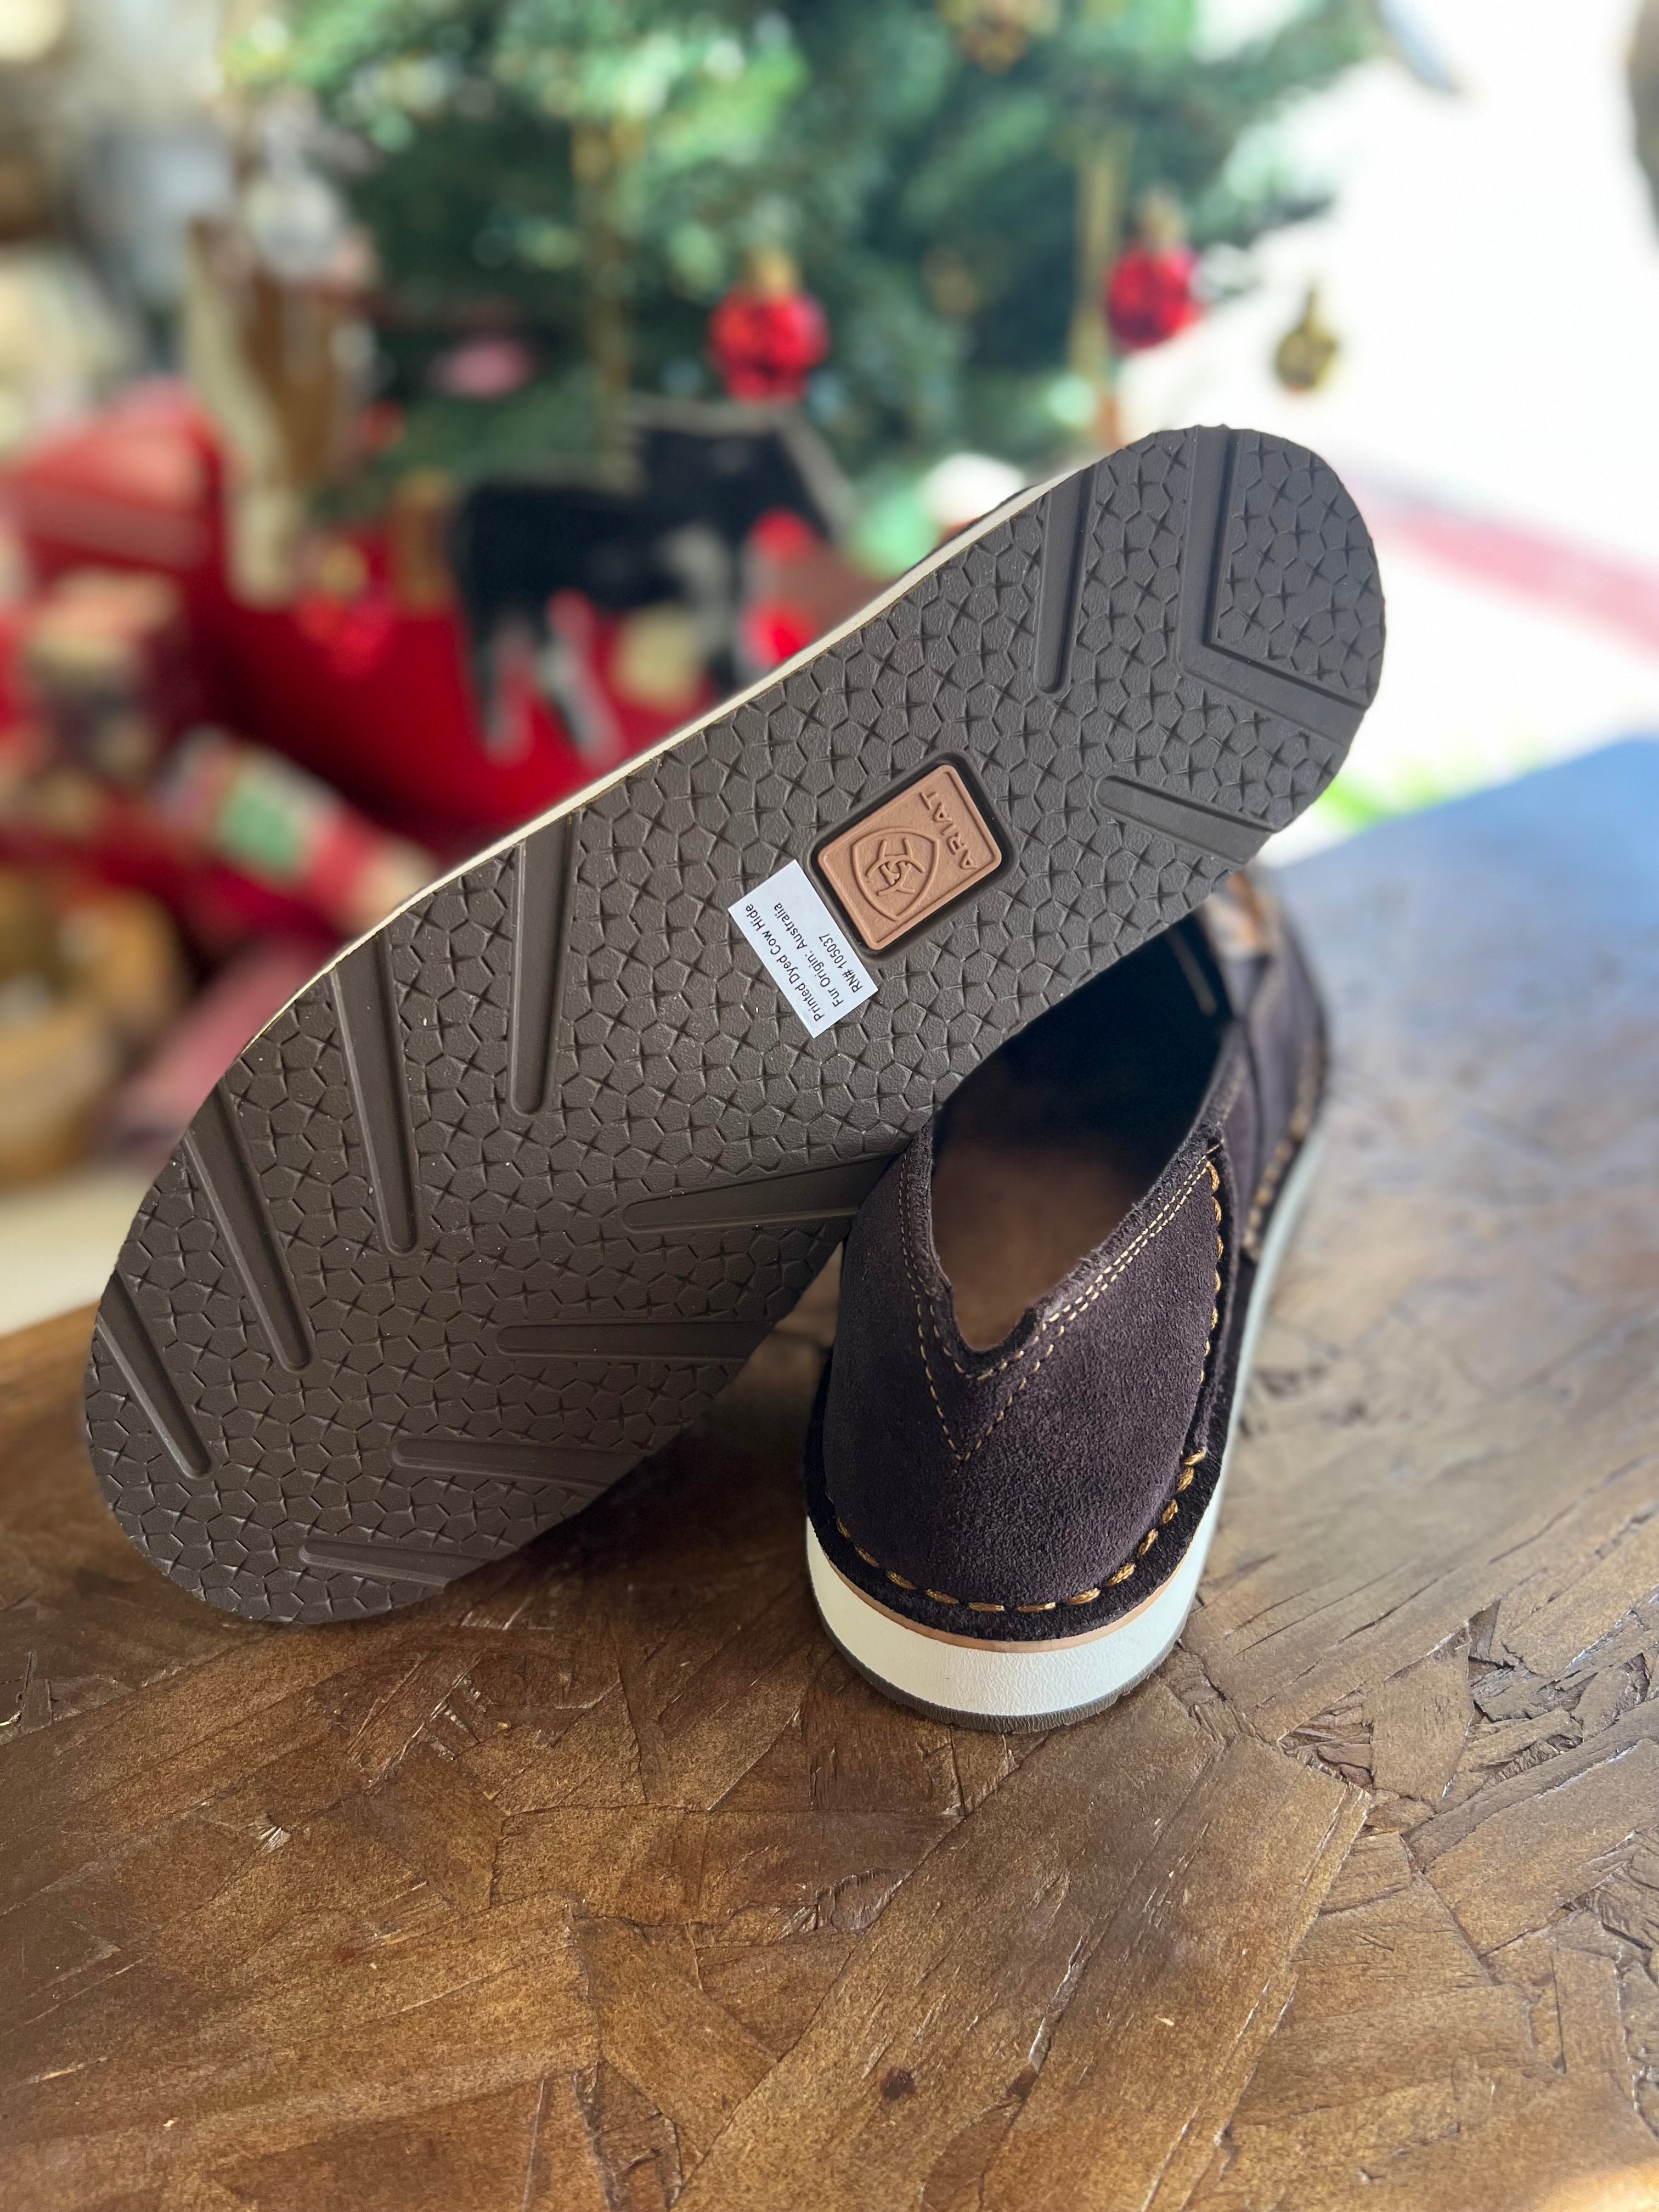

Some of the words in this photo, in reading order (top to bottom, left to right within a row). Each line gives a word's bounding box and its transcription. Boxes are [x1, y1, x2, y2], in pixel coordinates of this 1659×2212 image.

[920, 790, 978, 871] ARIAT
[746, 904, 765, 931] Hide
[774, 902, 808, 950] Australia
[761, 930, 781, 955] Cow
[819, 934, 847, 968] 105037
[776, 954, 800, 984] Dyed
[805, 951, 831, 988] Origin:
[842, 969, 863, 993] RN#
[794, 982, 825, 1022] Printed
[827, 988, 844, 1008] Fur
